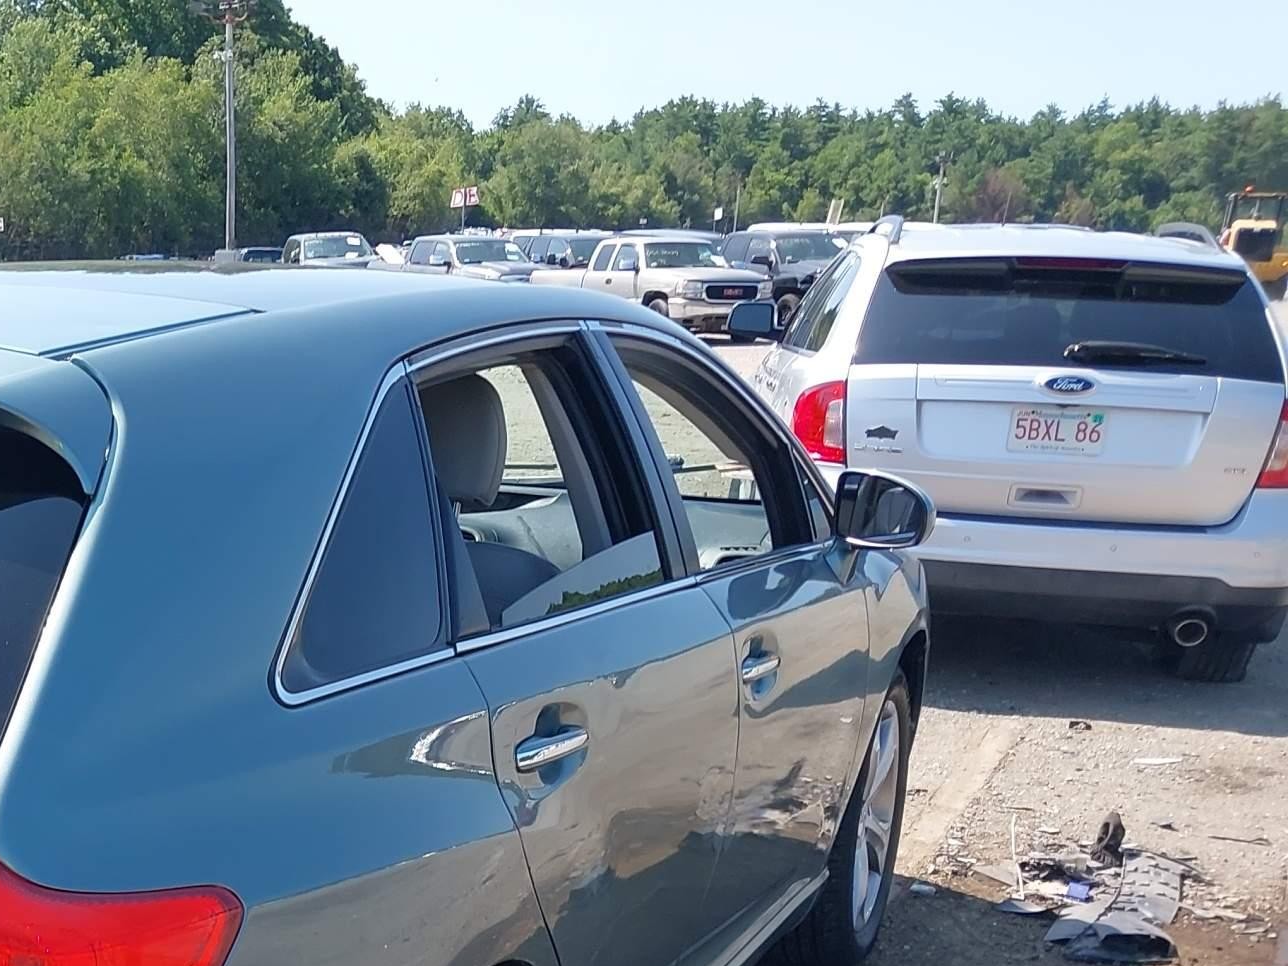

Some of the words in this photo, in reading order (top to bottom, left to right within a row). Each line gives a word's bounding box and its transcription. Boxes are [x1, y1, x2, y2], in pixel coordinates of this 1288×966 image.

[1053, 377, 1085, 391] Ford
[1014, 418, 1066, 442] 5BXL
[1075, 421, 1103, 443] 86
